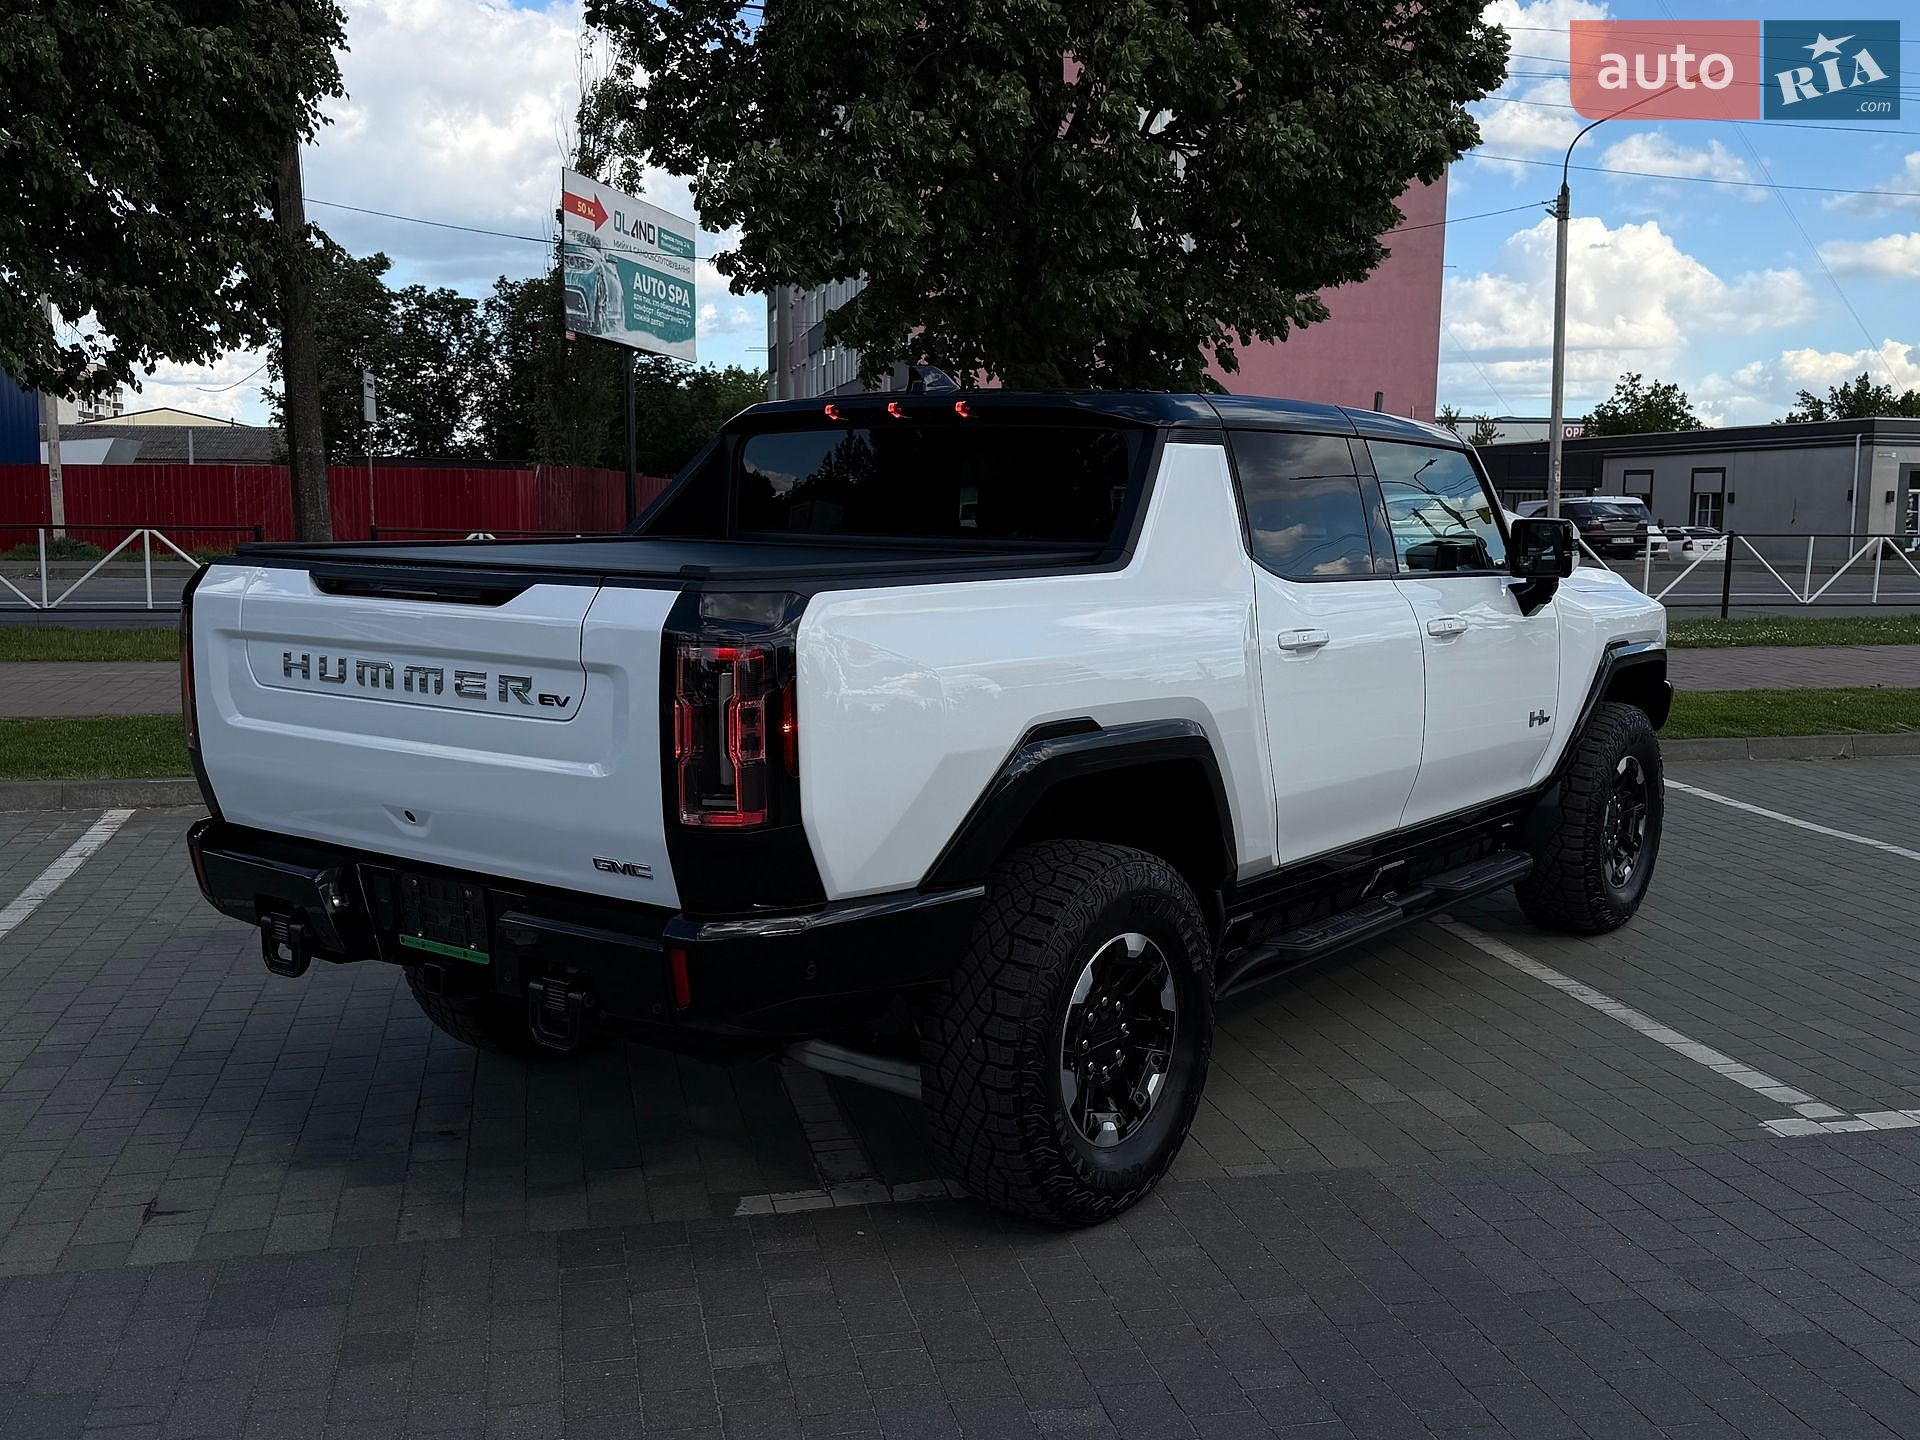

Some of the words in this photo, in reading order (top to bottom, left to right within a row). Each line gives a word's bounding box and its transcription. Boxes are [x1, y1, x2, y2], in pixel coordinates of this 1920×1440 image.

[577, 201, 586, 212] 50
[614, 210, 656, 245] OLAND
[633, 272, 666, 299] AUTO
[668, 284, 690, 308] SPA
[282, 651, 535, 706] HUMMER
[537, 693, 571, 708] EV
[592, 856, 654, 880] GMC
